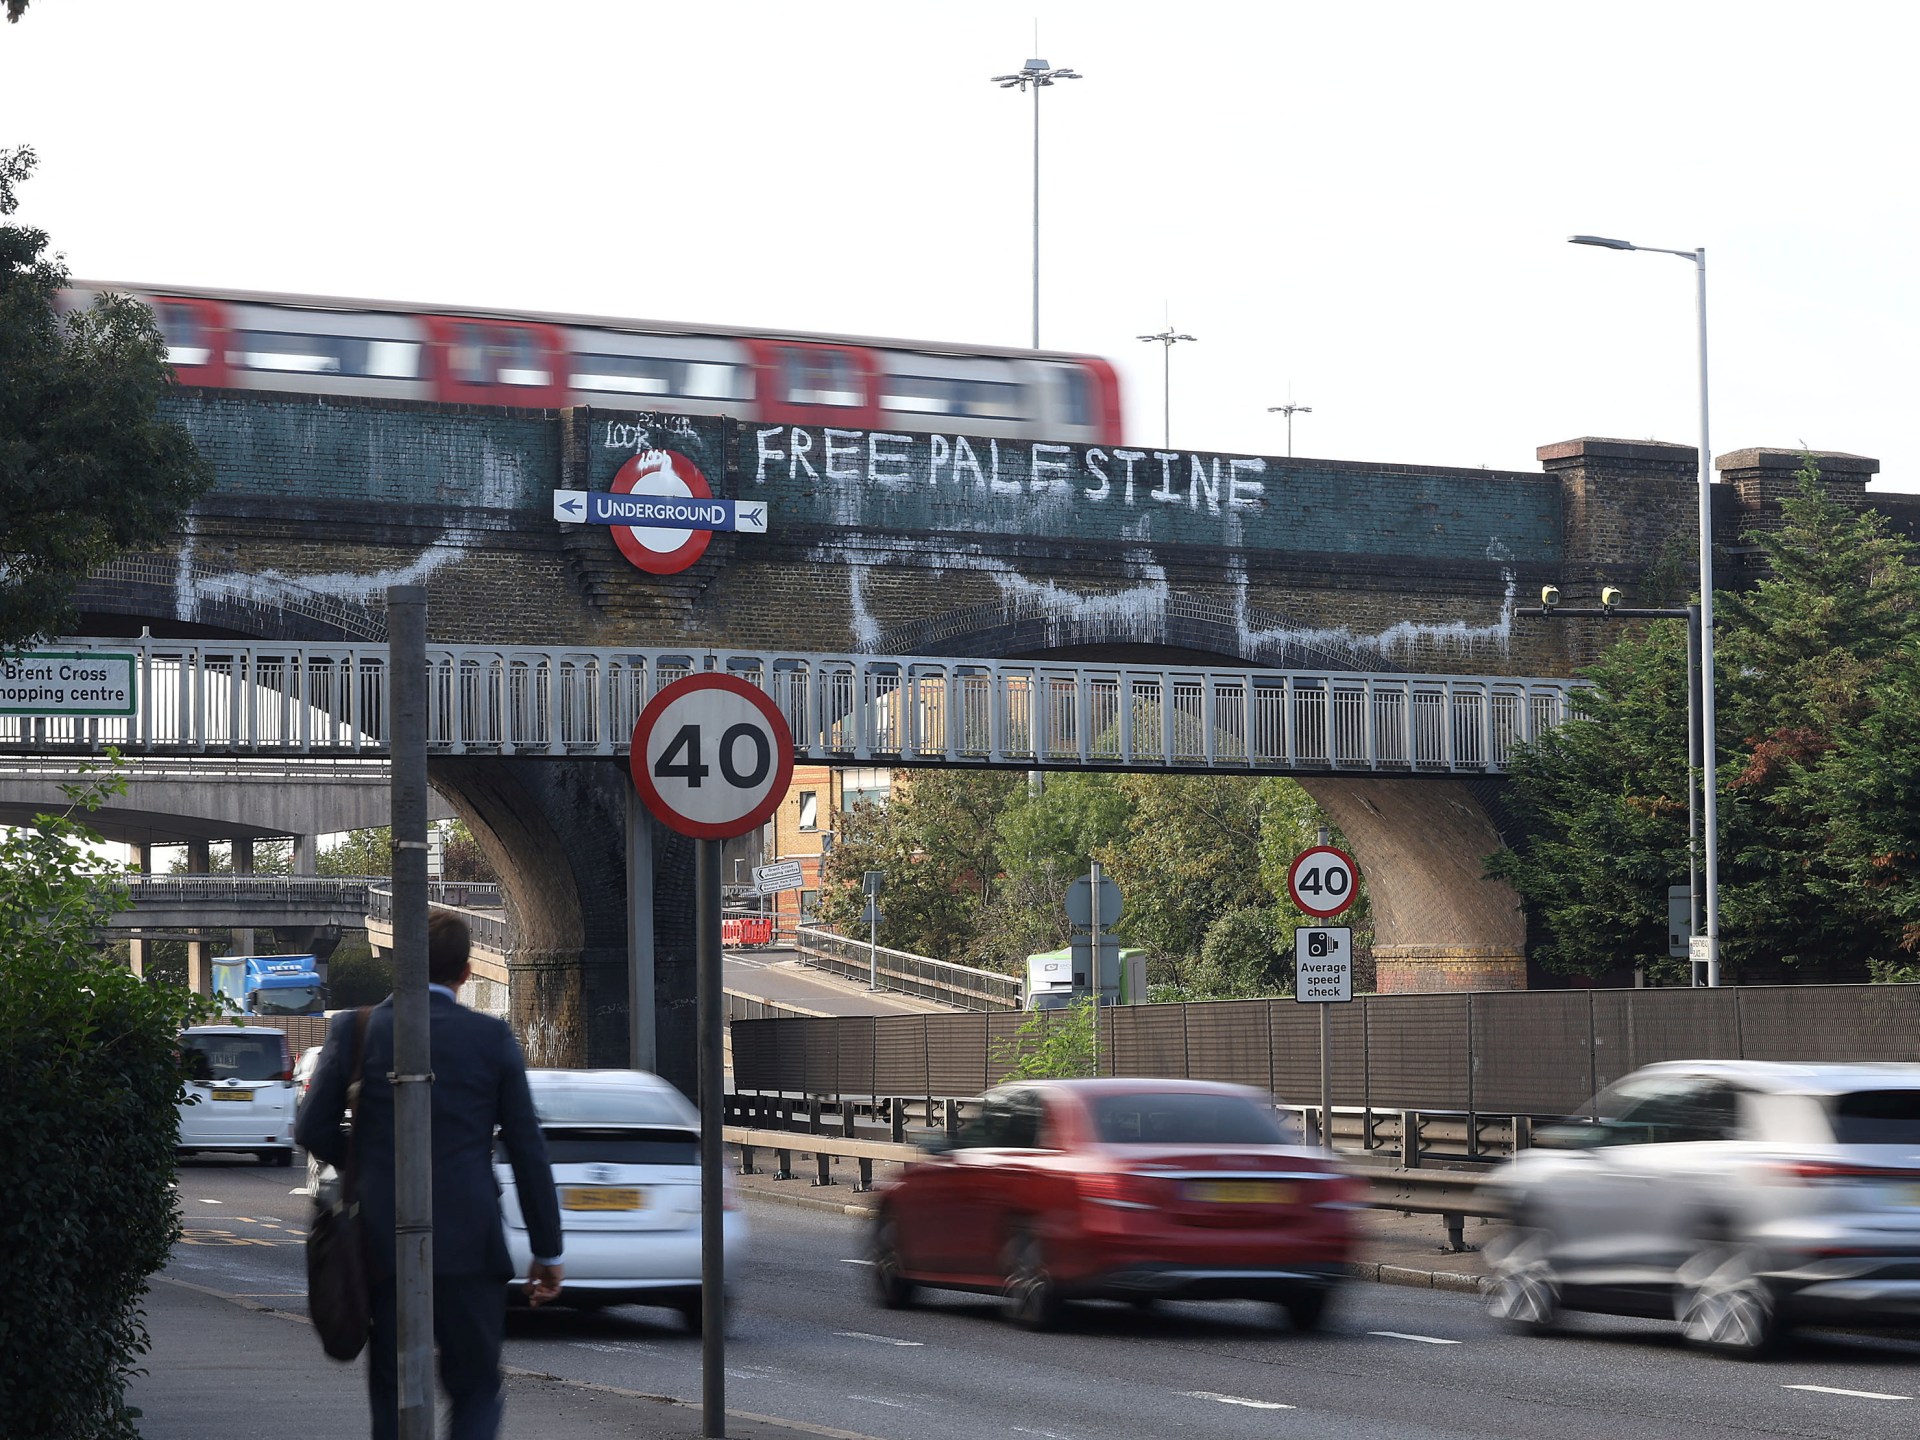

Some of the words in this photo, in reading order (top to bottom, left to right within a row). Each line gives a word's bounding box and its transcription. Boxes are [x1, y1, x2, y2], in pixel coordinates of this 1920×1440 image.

[755, 426, 914, 484] FREE
[929, 435, 1267, 516] PALESTINE
[597, 499, 726, 524] UNDERGROUND
[6, 665, 52, 680] Brent
[59, 666, 107, 681] Cross
[0, 686, 64, 703] opping
[71, 687, 124, 701] centre
[654, 723, 771, 789] 40
[1299, 867, 1348, 896] 40
[1301, 963, 1347, 974] Average
[1307, 975, 1340, 986] speed
[1307, 987, 1340, 996] check
